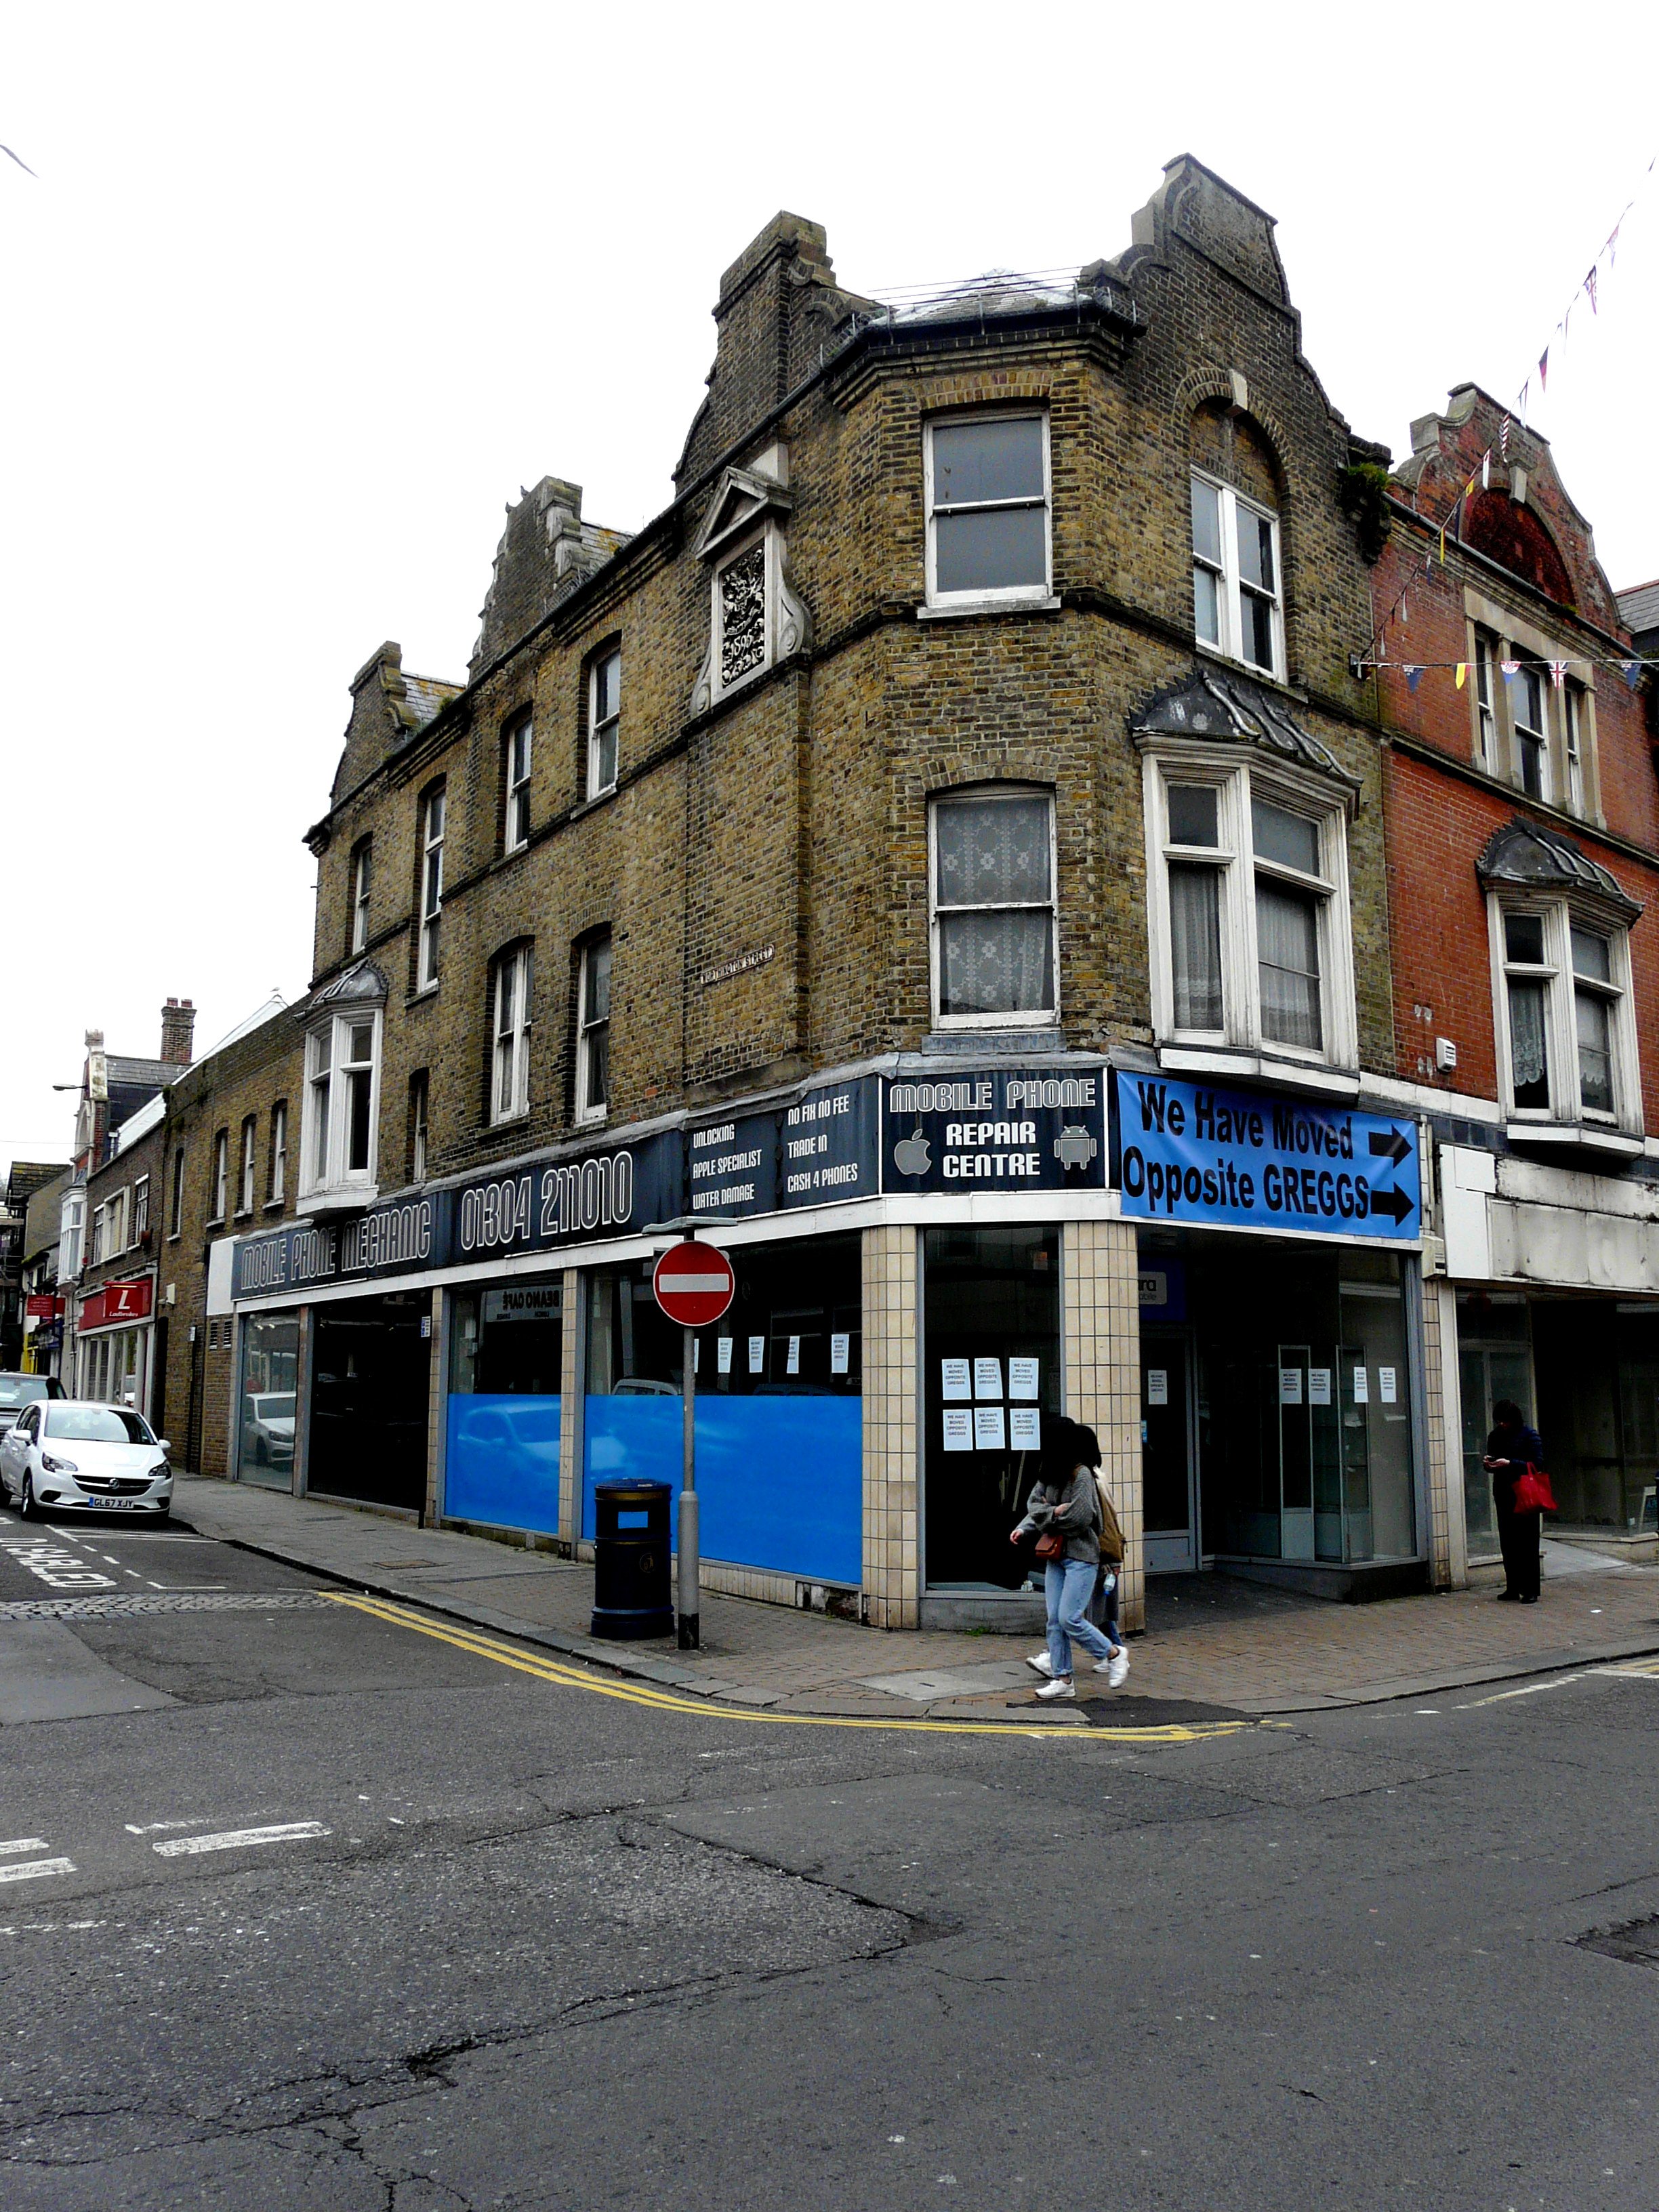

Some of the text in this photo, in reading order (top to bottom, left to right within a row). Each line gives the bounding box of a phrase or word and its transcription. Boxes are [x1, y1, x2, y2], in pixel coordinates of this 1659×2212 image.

[890, 1078, 1096, 1113] MOBILE PHONE
[787, 1094, 849, 1126] NO FIX NO FEE
[1137, 1081, 1354, 1160] We Have Moved
[693, 1124, 735, 1149] UNLOCKING
[787, 1134, 827, 1159] TRADE IN
[946, 1122, 1036, 1146] REPAIR
[693, 1149, 762, 1179] APPLE SPECIALIST
[787, 1163, 858, 1193] CASH 4 PHONES
[943, 1153, 1040, 1178] CENTRE
[1124, 1145, 1370, 1219] Opposite GREGGS
[693, 1183, 755, 1210] WATER DAMAGE
[241, 1151, 633, 1290] MOBILE PHONE MECHANIC 01304 211010
[118, 1290, 130, 1309] L
[94, 1498, 134, 1508] GL67 XJY
